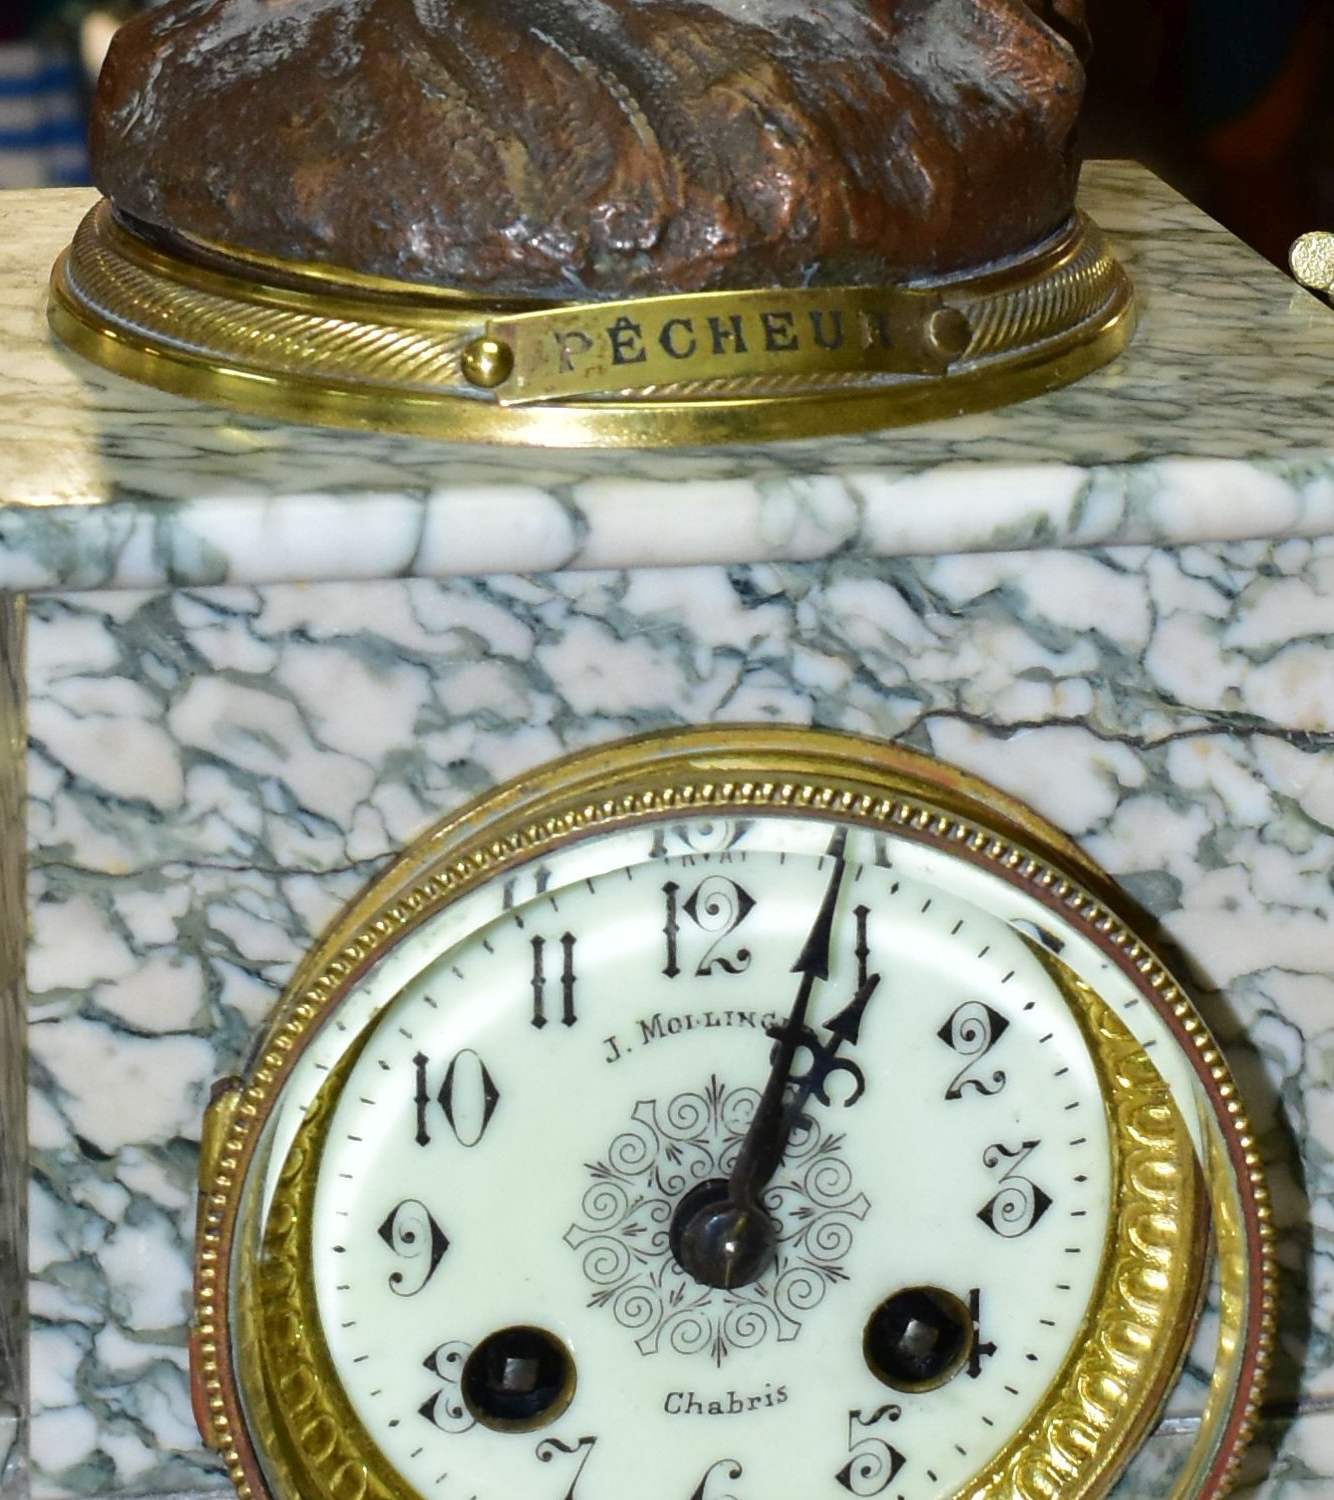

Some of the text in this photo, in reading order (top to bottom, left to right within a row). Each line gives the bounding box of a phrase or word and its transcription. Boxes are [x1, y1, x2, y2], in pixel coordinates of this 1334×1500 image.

[662, 874, 756, 979] 12
[529, 931, 578, 1030] 11
[412, 1048, 501, 1149] 10
[602, 1034, 633, 1064] J.
[936, 1000, 1009, 1101] 2
[975, 1139, 1054, 1240] 3
[377, 1198, 450, 1297] 9
[662, 1381, 790, 1417] Chabris
[834, 1403, 907, 1498] 5
